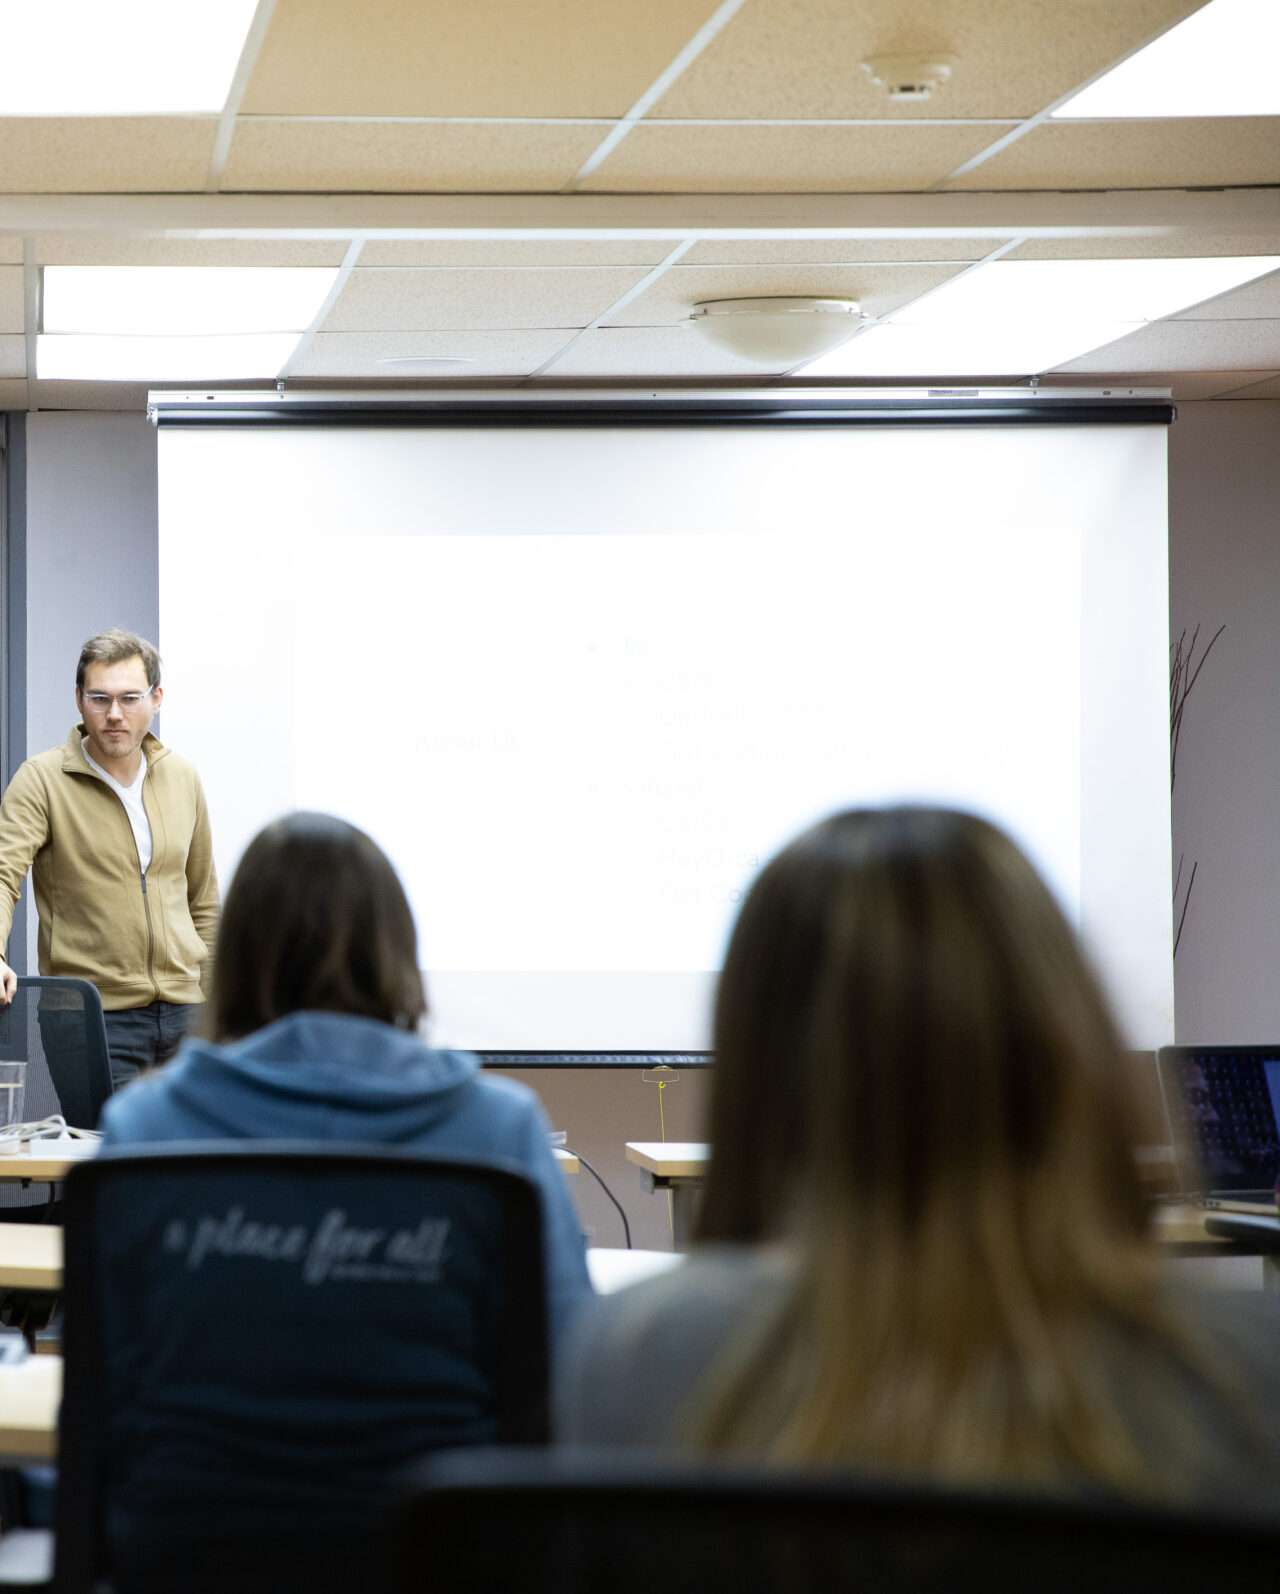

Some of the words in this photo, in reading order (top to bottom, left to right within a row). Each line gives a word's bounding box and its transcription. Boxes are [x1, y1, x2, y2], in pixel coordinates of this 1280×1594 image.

[415, 731, 483, 752] About
[491, 731, 521, 752] Us
[658, 742, 702, 762] Get
[708, 742, 795, 767] Coding
[658, 882, 704, 903] Get
[301, 1207, 383, 1286] for
